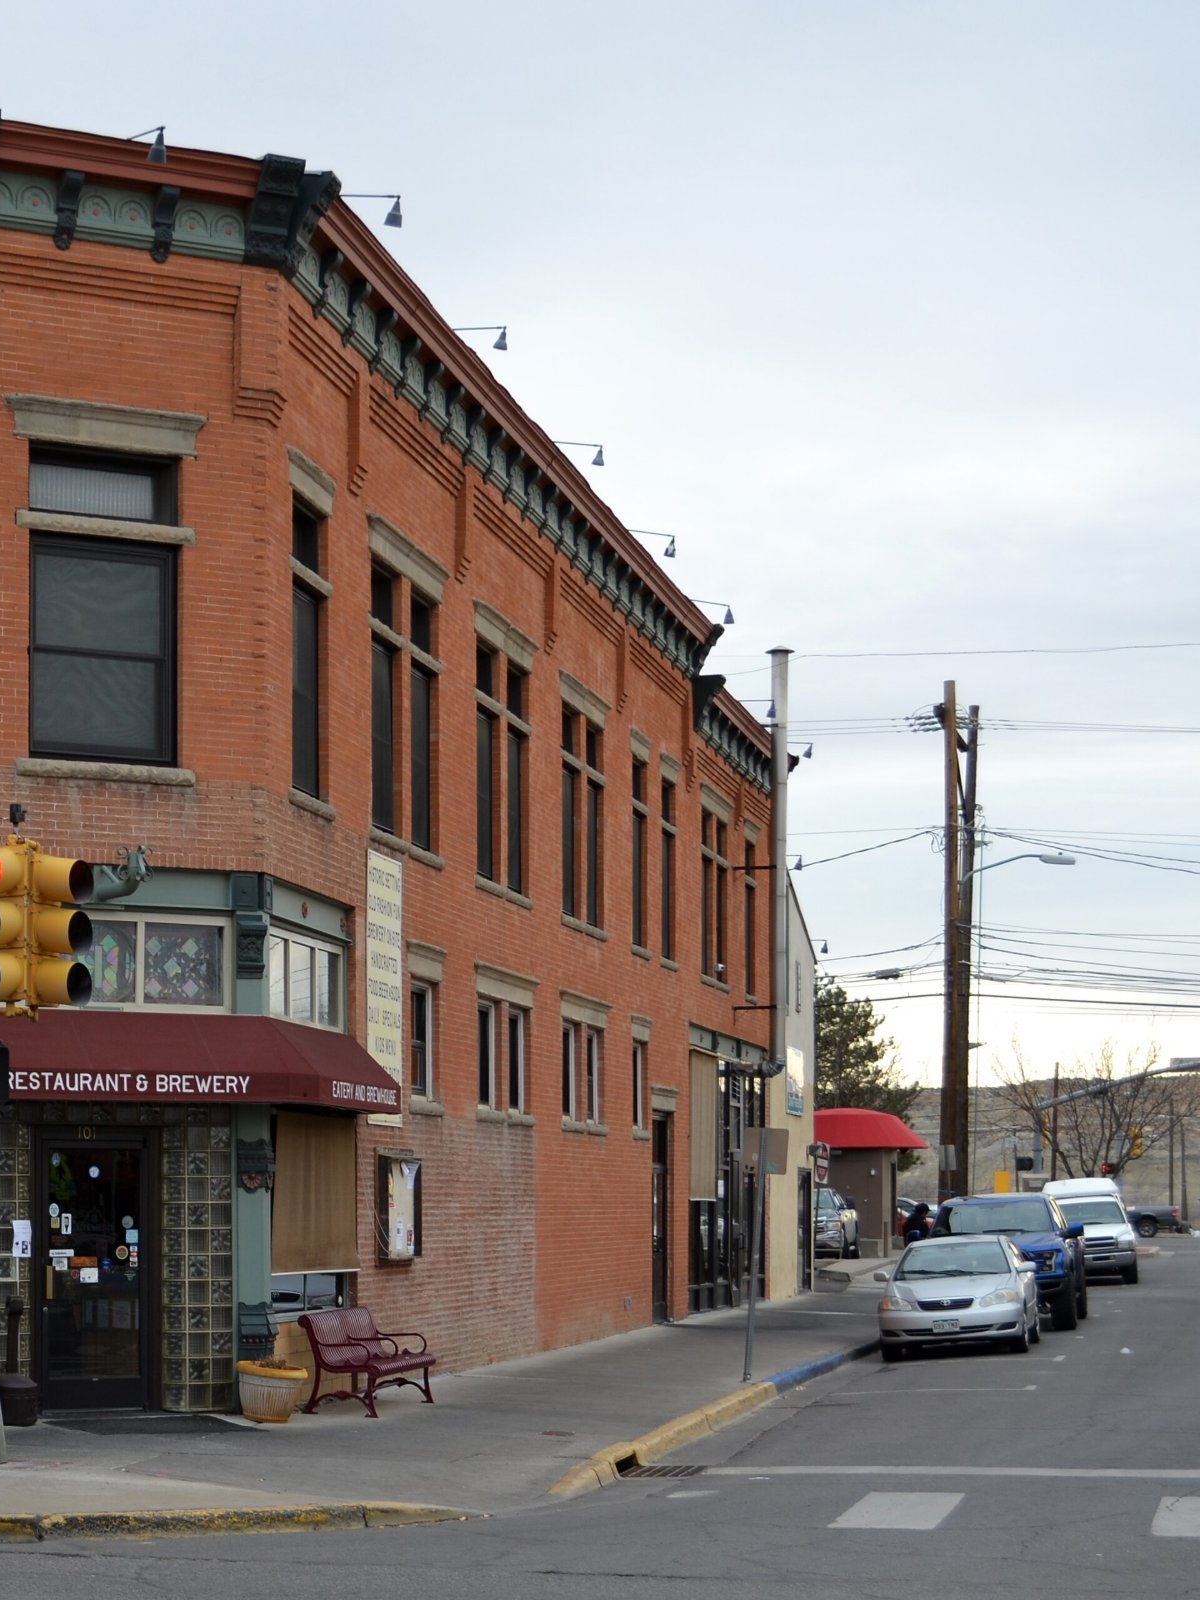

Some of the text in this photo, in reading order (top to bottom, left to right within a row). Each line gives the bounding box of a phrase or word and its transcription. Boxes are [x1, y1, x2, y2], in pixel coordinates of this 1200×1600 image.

[8, 1071, 250, 1094] RESTAURANT & BREWERY
[332, 1080, 398, 1106] EATERY AND BREWHOUSE
[77, 1126, 96, 1140] 101
